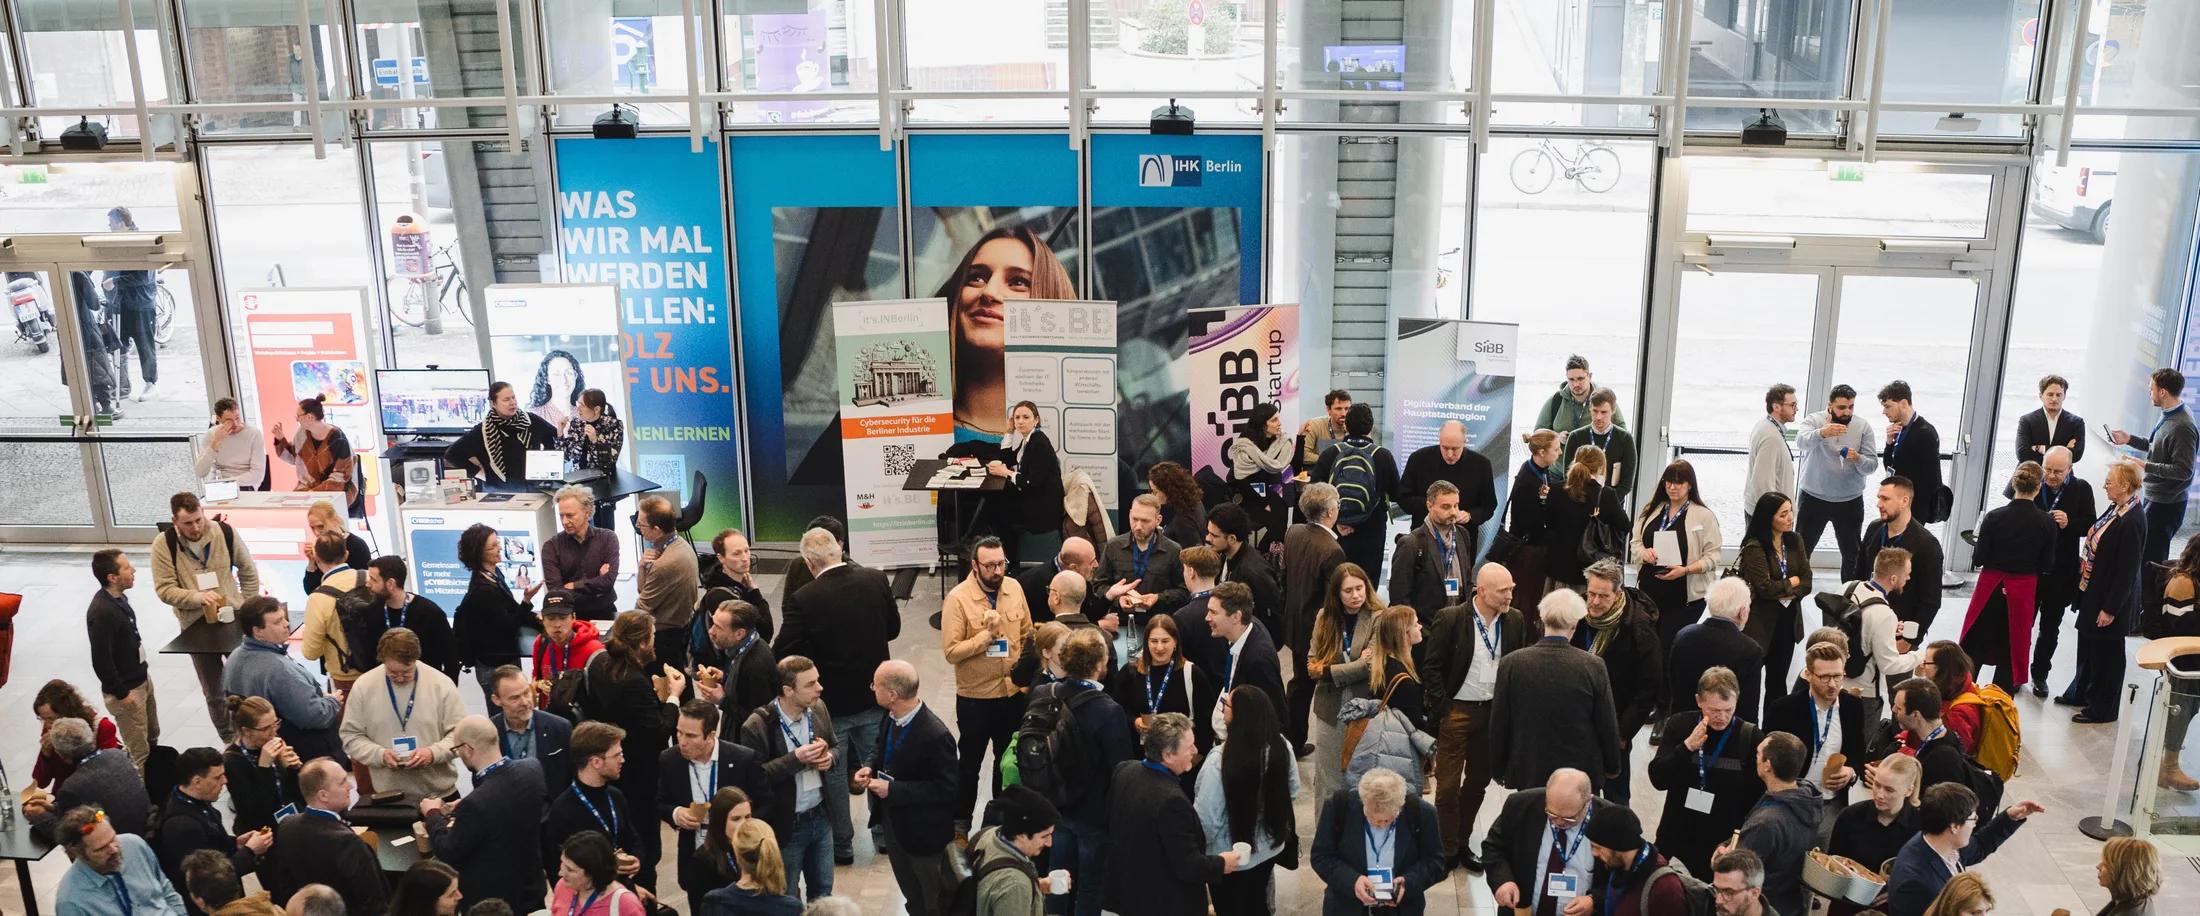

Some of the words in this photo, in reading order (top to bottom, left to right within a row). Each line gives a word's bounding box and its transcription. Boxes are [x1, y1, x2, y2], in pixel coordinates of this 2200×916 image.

[1174, 160, 1199, 172] IHK
[1206, 159, 1242, 172] Berlin
[560, 190, 637, 219] WAS
[563, 226, 631, 255] WIR
[640, 225, 712, 254] MAL
[566, 261, 708, 289] WERDEN
[622, 296, 716, 325] LLEN:
[1474, 339, 1504, 354] SiBB
[1267, 329, 1285, 413] startup
[650, 366, 730, 394] UNS.
[1403, 400, 1473, 411] Digitalverband
[1474, 403, 1491, 412] der
[1403, 408, 1486, 421] Hauptstadtregion
[860, 417, 910, 428] Cybersecurity
[911, 416, 922, 424] für
[634, 426, 731, 440] NENLERNEN
[866, 427, 896, 436] Berliner
[897, 426, 930, 434] Industrie
[421, 561, 460, 569] Gemeinsam
[423, 570, 433, 578] für
